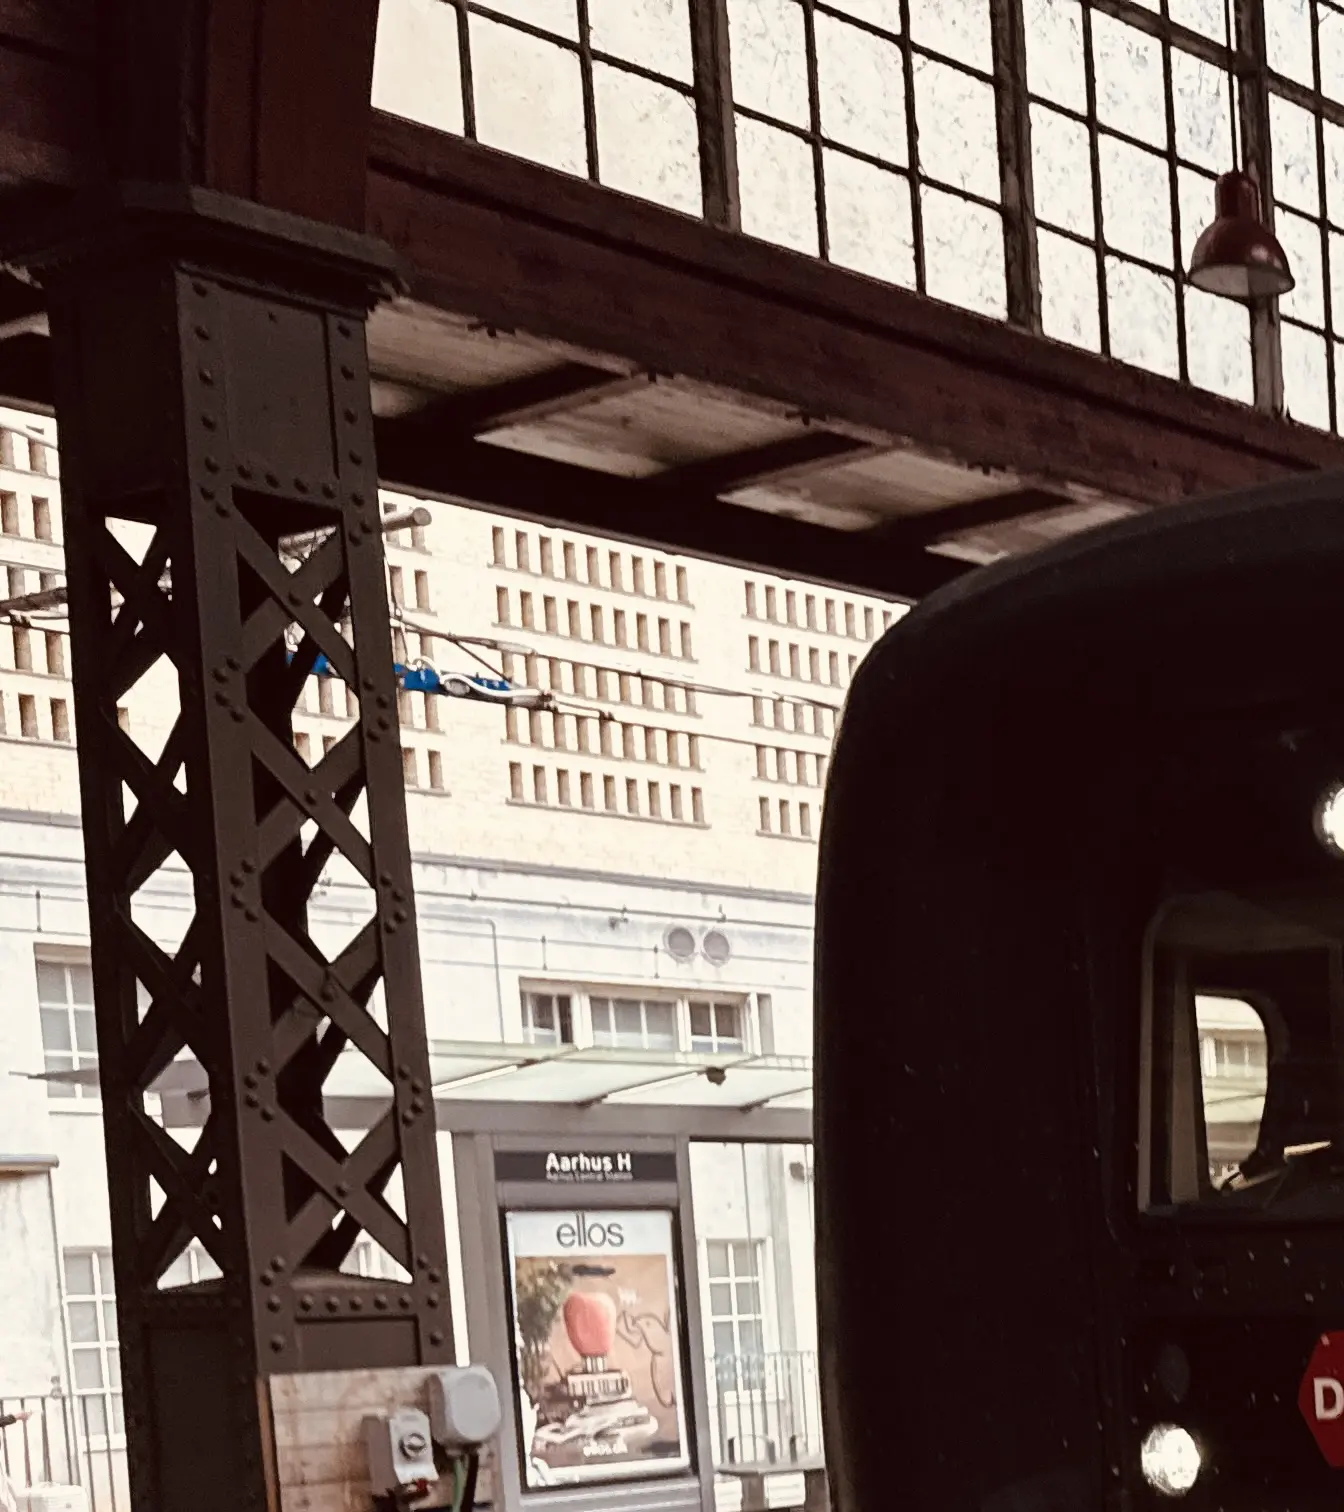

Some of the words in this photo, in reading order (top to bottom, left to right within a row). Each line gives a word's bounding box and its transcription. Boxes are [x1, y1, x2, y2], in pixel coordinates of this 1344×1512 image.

[545, 1152, 613, 1172] Aarhus
[617, 1152, 632, 1172] H
[556, 1211, 624, 1248] ellos
